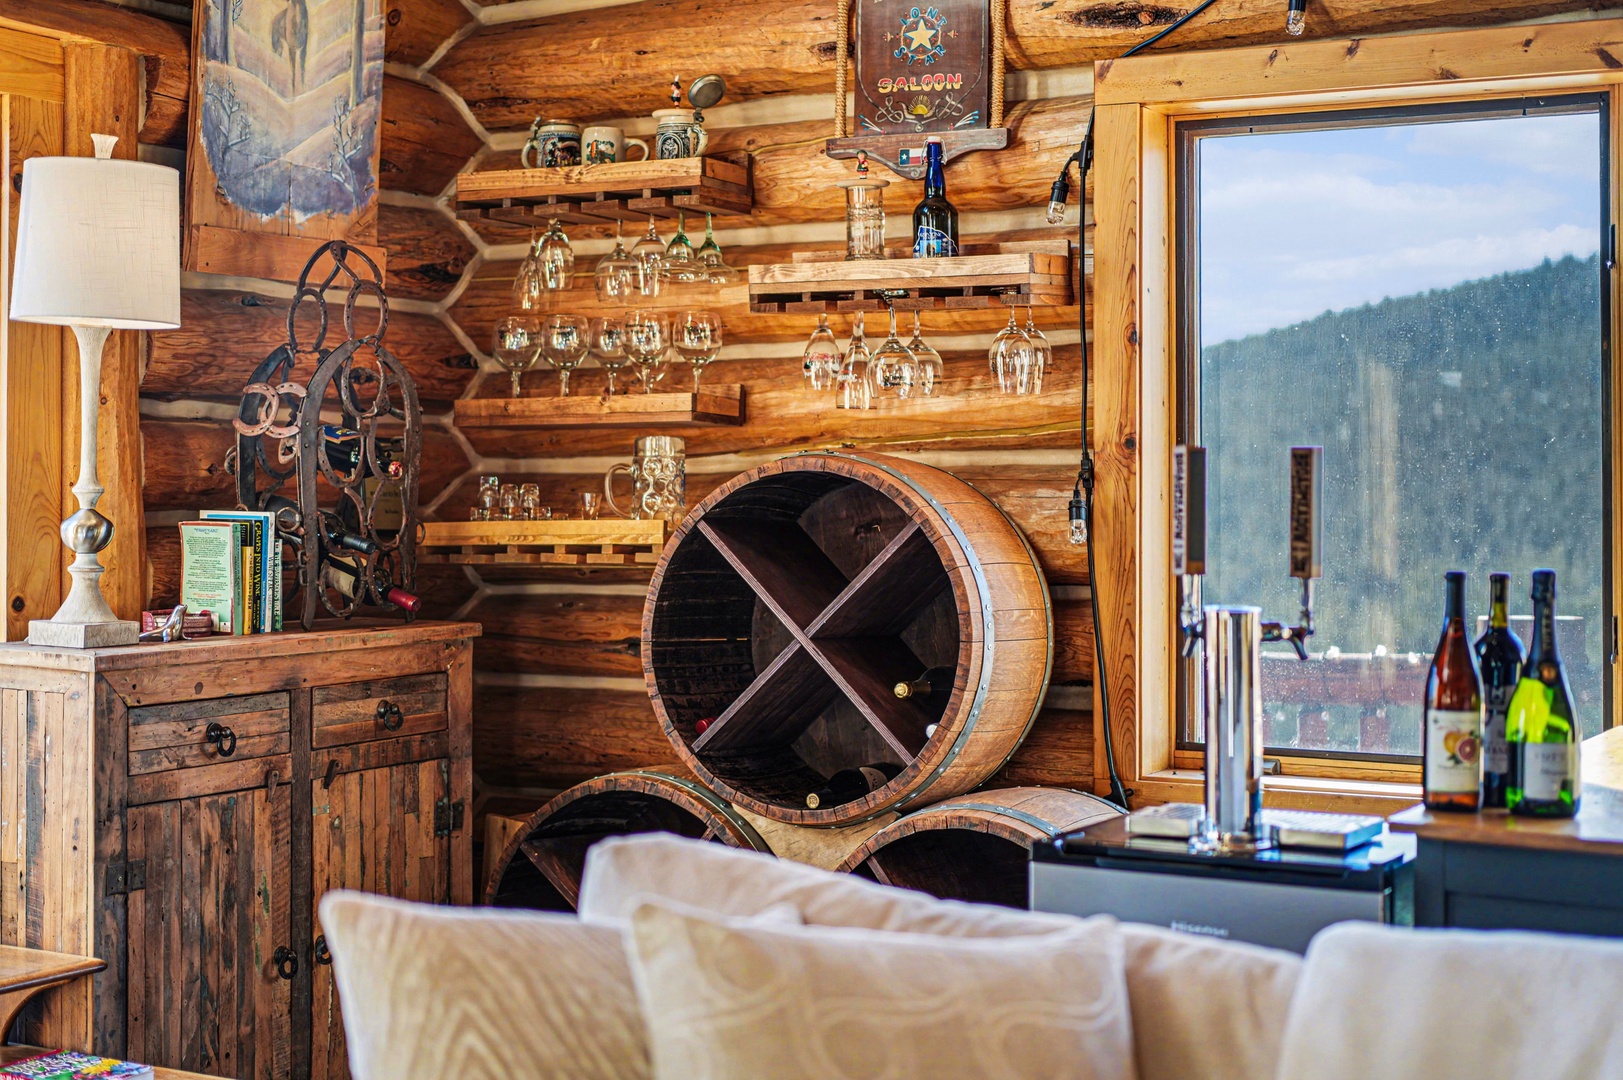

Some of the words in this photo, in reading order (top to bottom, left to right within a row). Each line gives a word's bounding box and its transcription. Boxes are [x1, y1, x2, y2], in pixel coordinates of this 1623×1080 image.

[900, 6, 947, 29] LONE
[894, 44, 946, 66] STAR
[877, 72, 962, 94] SALOON
[254, 521, 262, 552] GRAPES
[253, 573, 261, 597] WINE
